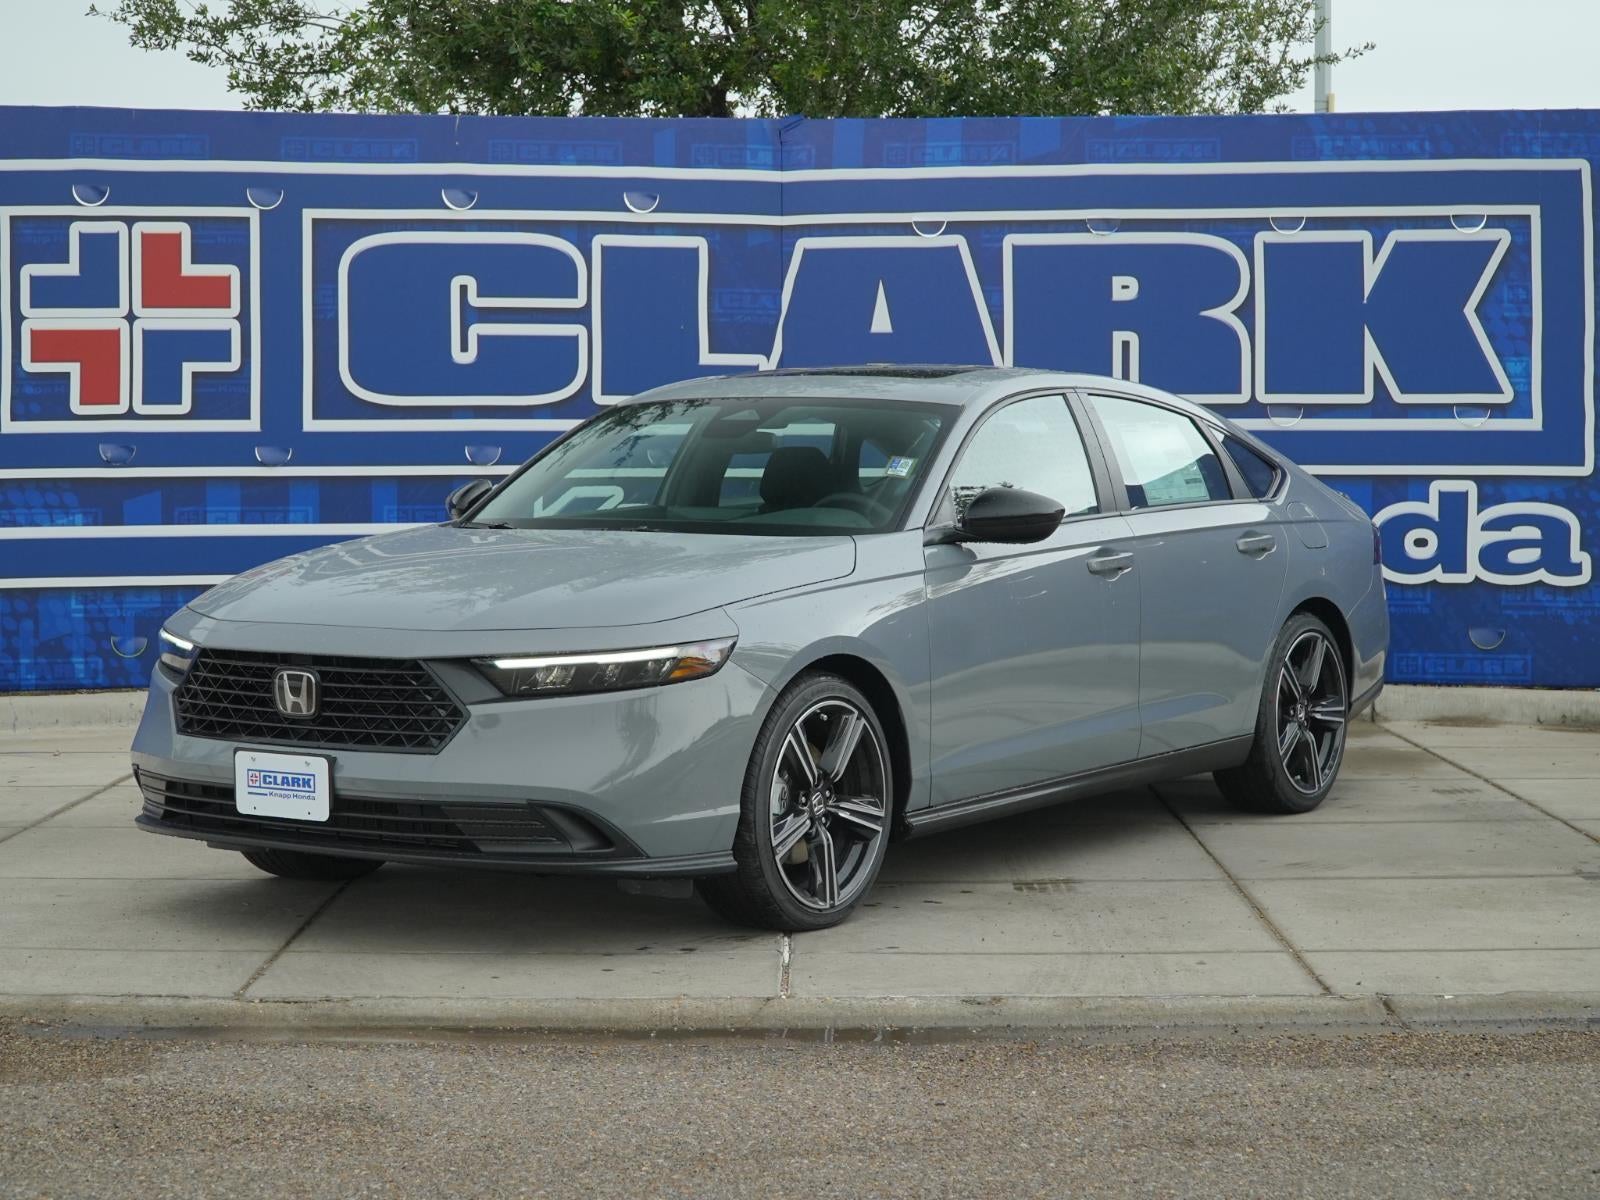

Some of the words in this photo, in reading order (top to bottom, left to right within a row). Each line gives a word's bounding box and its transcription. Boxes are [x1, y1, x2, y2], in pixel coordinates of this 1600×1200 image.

[338, 230, 1514, 406] CLARK
[262, 774, 312, 789] CLARK
[268, 791, 292, 800] Knapp
[292, 792, 316, 801] Honda
